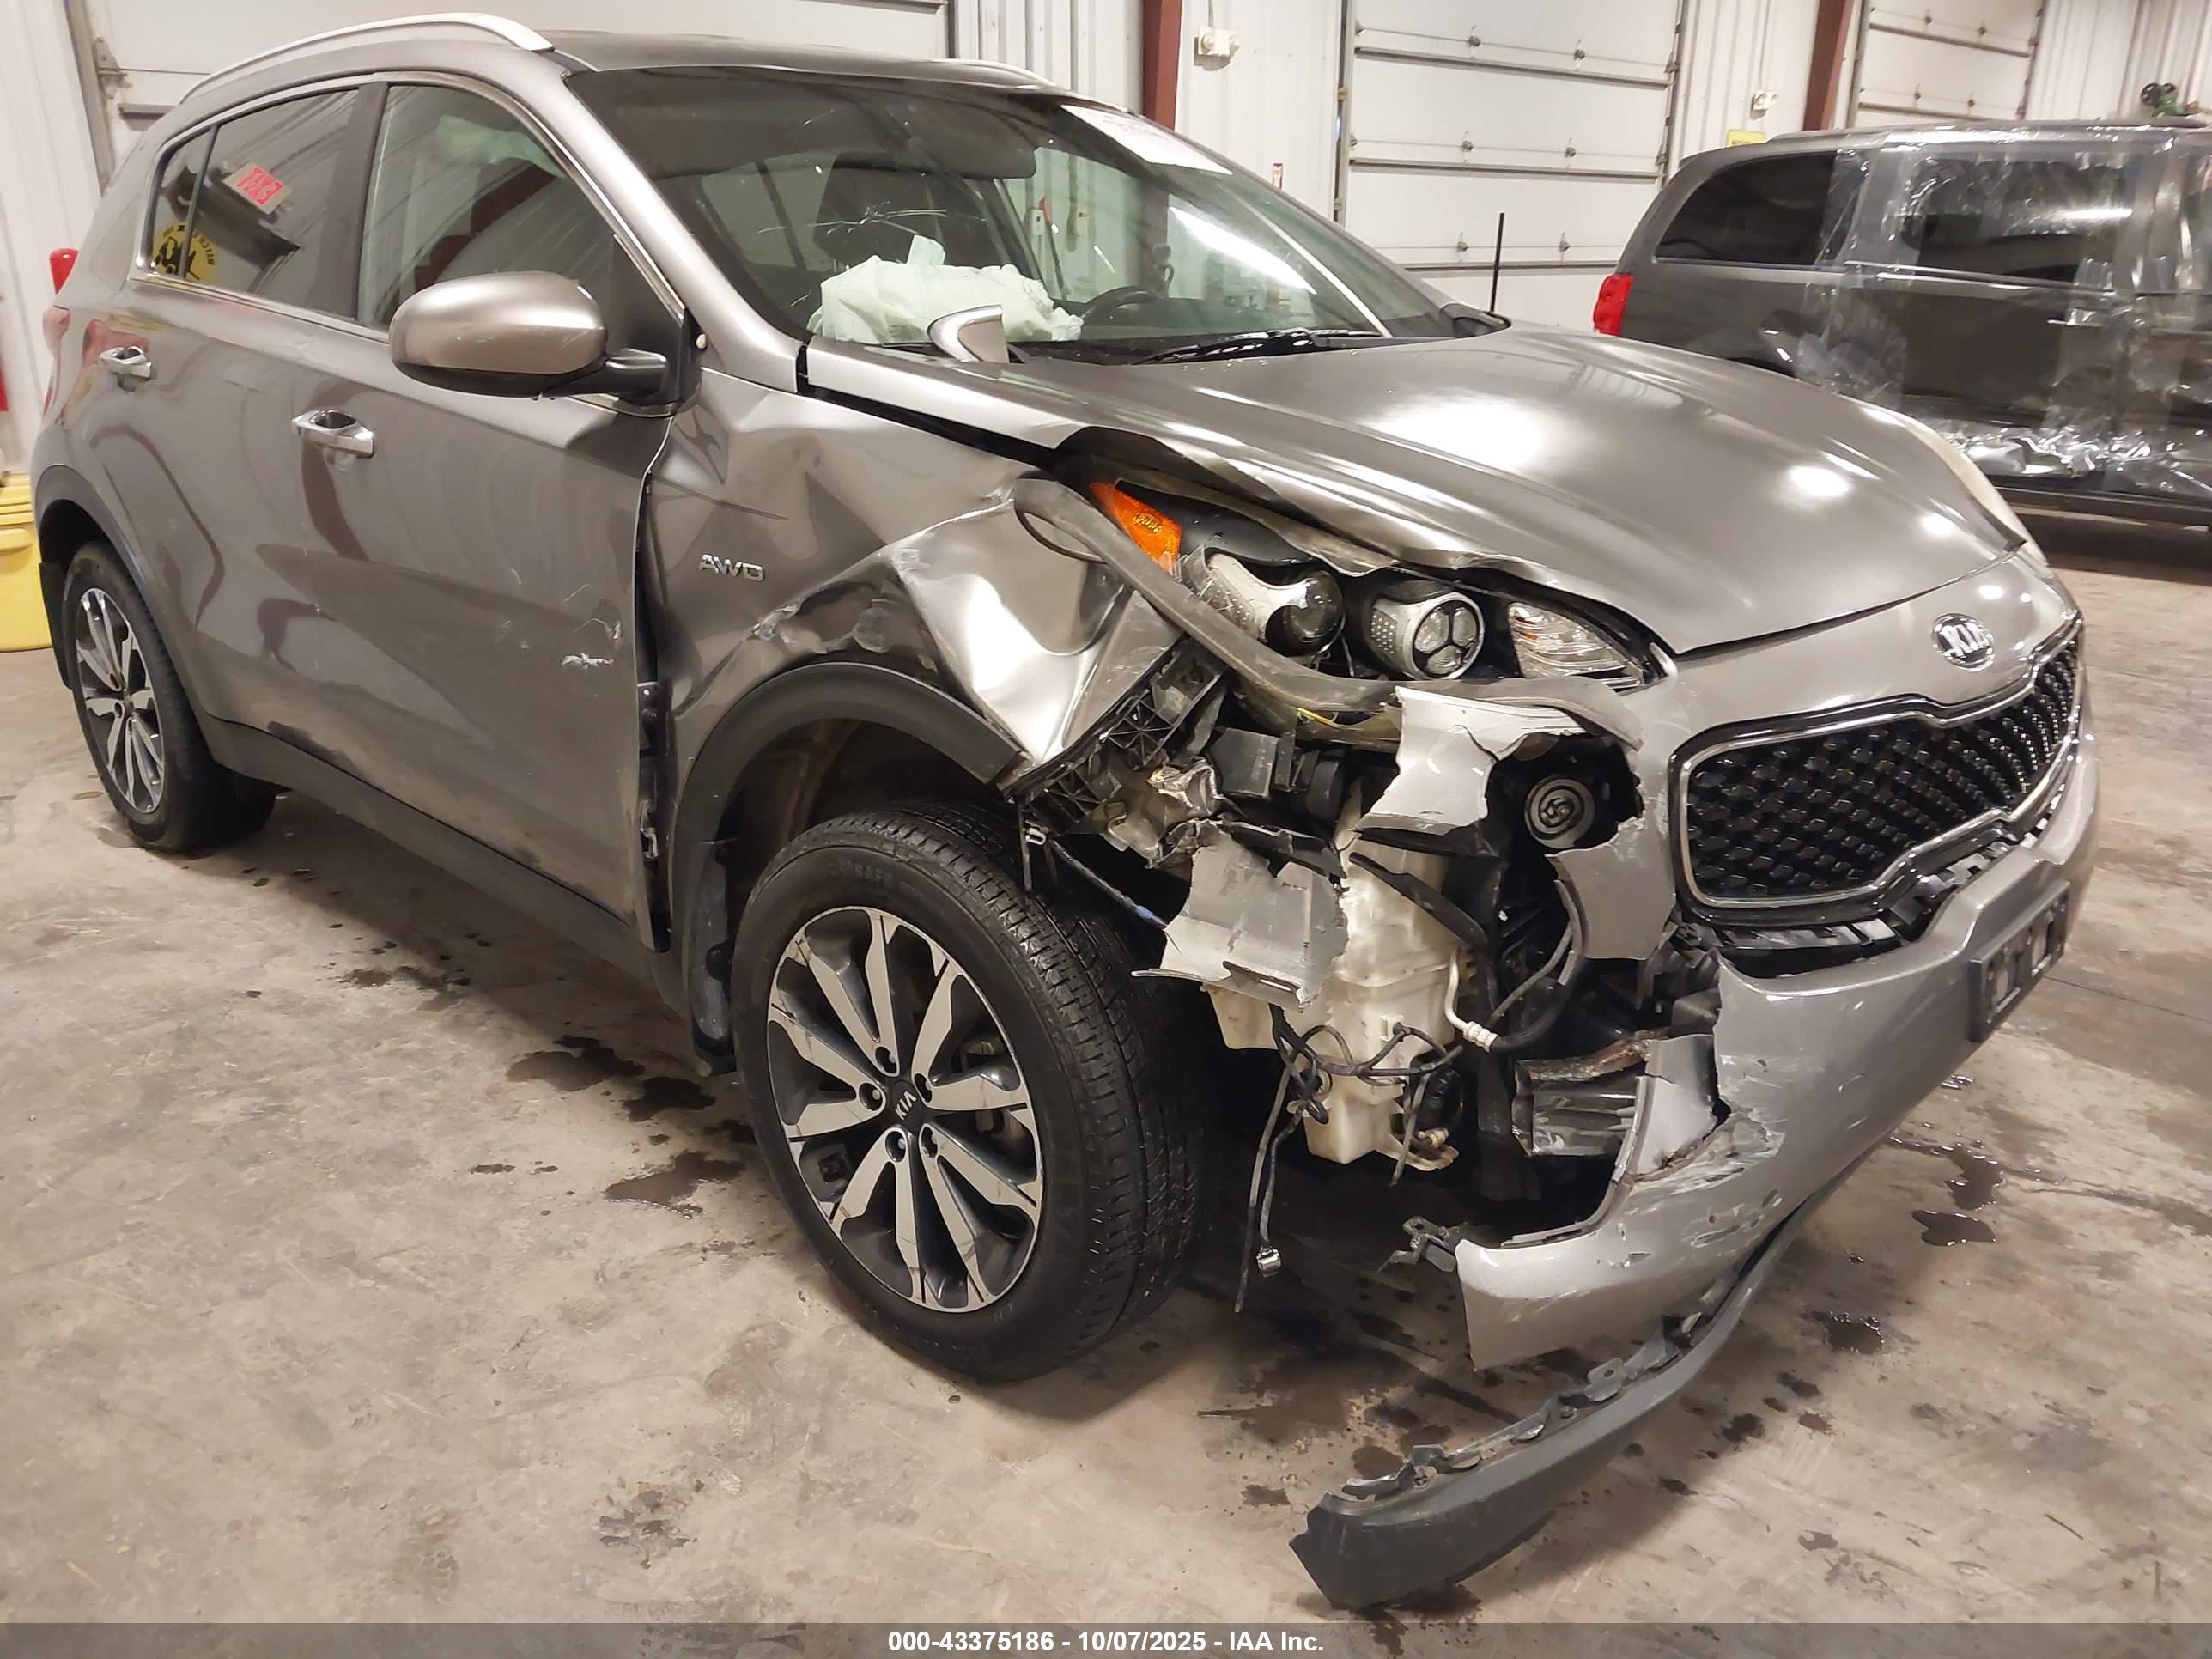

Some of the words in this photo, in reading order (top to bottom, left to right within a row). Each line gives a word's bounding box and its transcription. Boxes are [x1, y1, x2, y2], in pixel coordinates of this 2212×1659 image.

[699, 553, 764, 582] AWD
[1939, 623, 1990, 657] KIA
[894, 1091, 917, 1121] KIA
